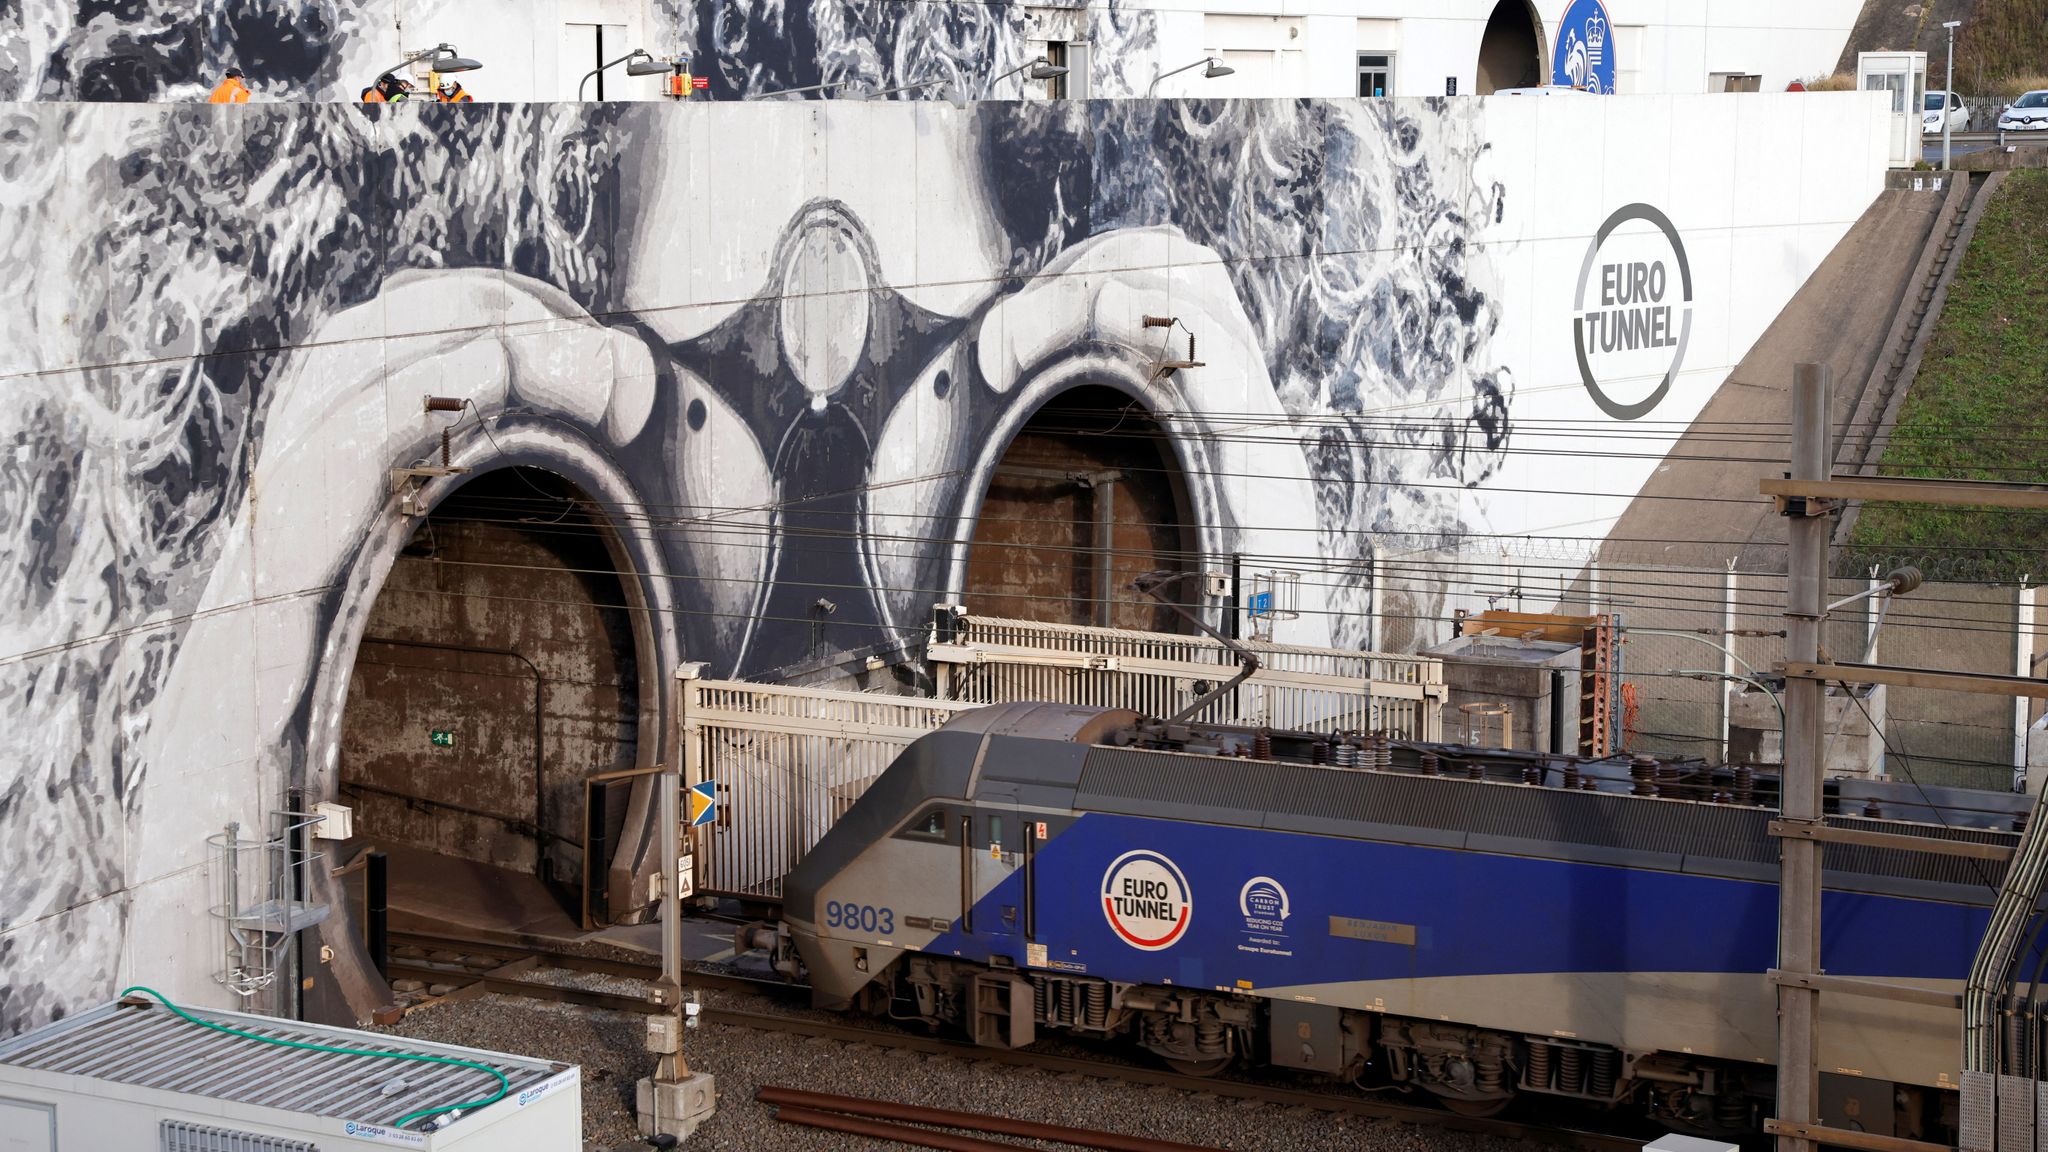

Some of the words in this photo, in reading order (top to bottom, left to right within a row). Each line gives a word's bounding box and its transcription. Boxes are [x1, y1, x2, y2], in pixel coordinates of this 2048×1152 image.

[1601, 260, 1666, 306] EURO
[1585, 305, 1677, 354] TUNNEL
[1123, 878, 1168, 900] EURO
[1249, 897, 1280, 905] CARBON
[826, 901, 895, 935] 9803
[1114, 897, 1177, 922] TUNNEL
[356, 1123, 386, 1136] Laroque
